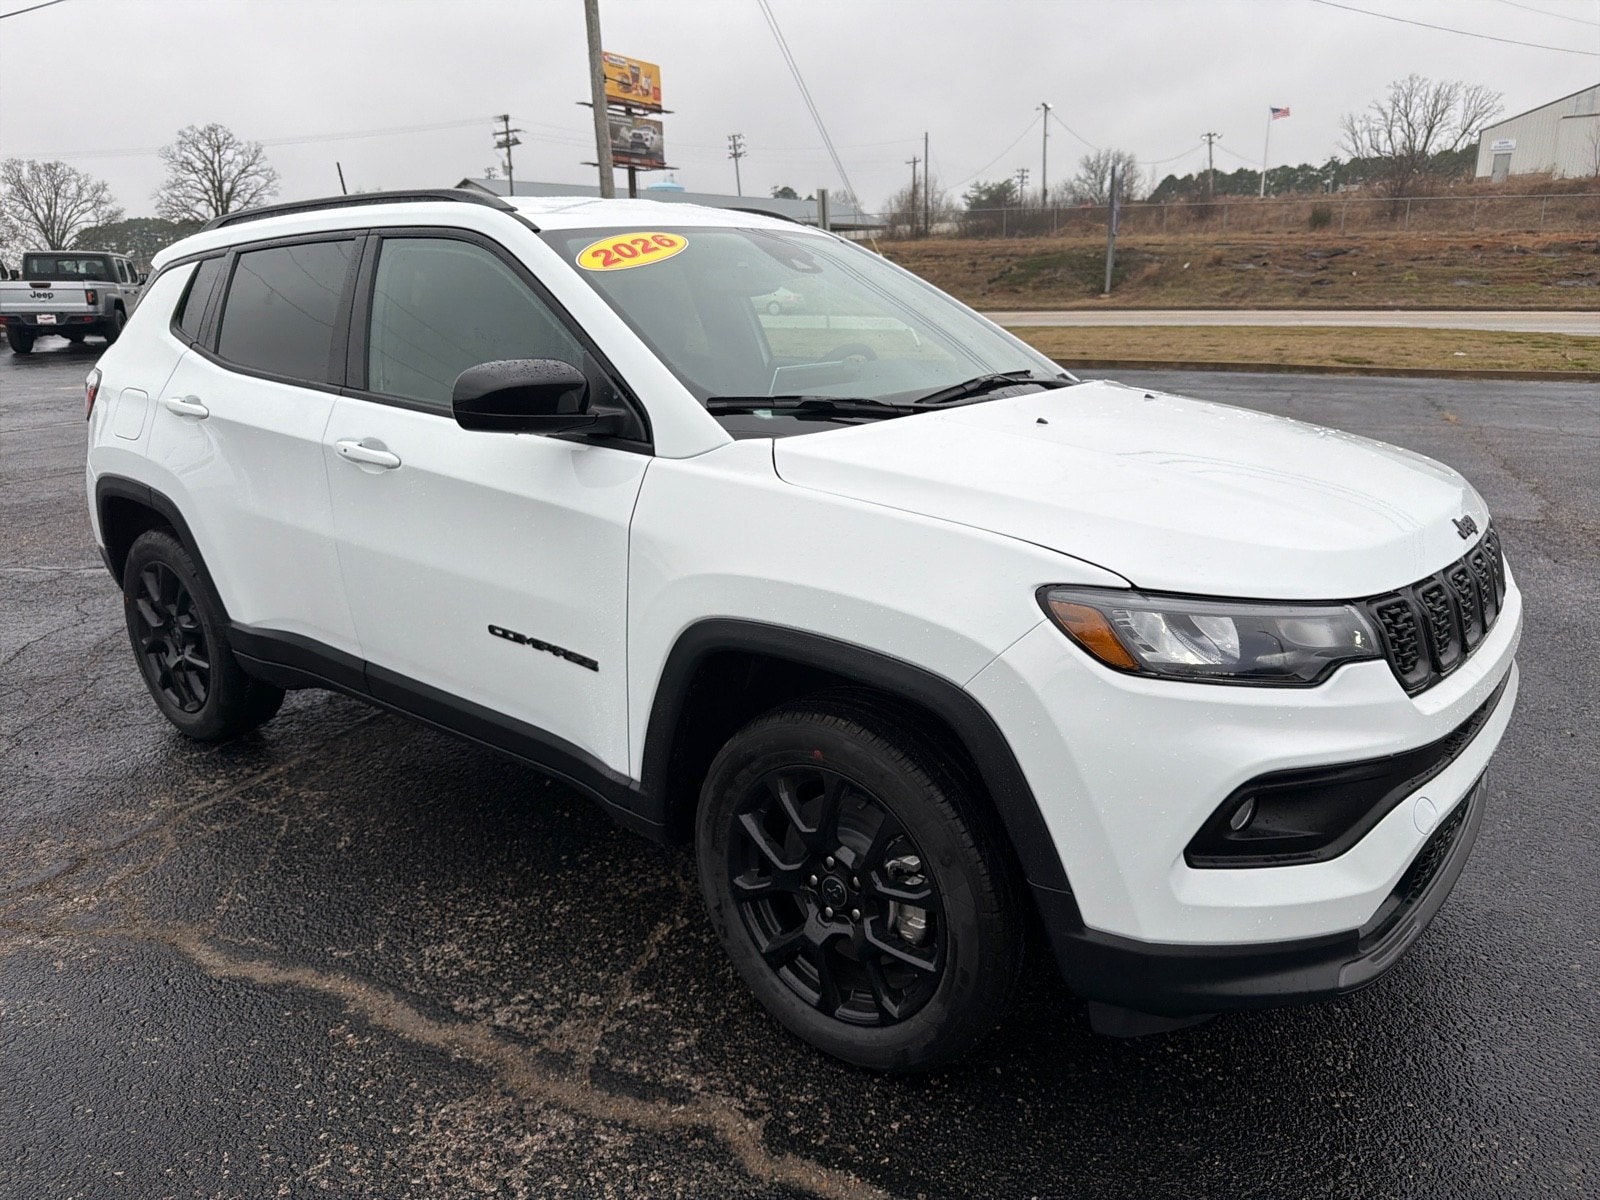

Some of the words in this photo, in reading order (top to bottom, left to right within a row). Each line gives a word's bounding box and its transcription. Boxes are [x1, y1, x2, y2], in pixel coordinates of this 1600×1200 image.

[591, 234, 677, 267] 2026
[30, 291, 54, 300] Jeep
[488, 624, 599, 672] COMPASS
